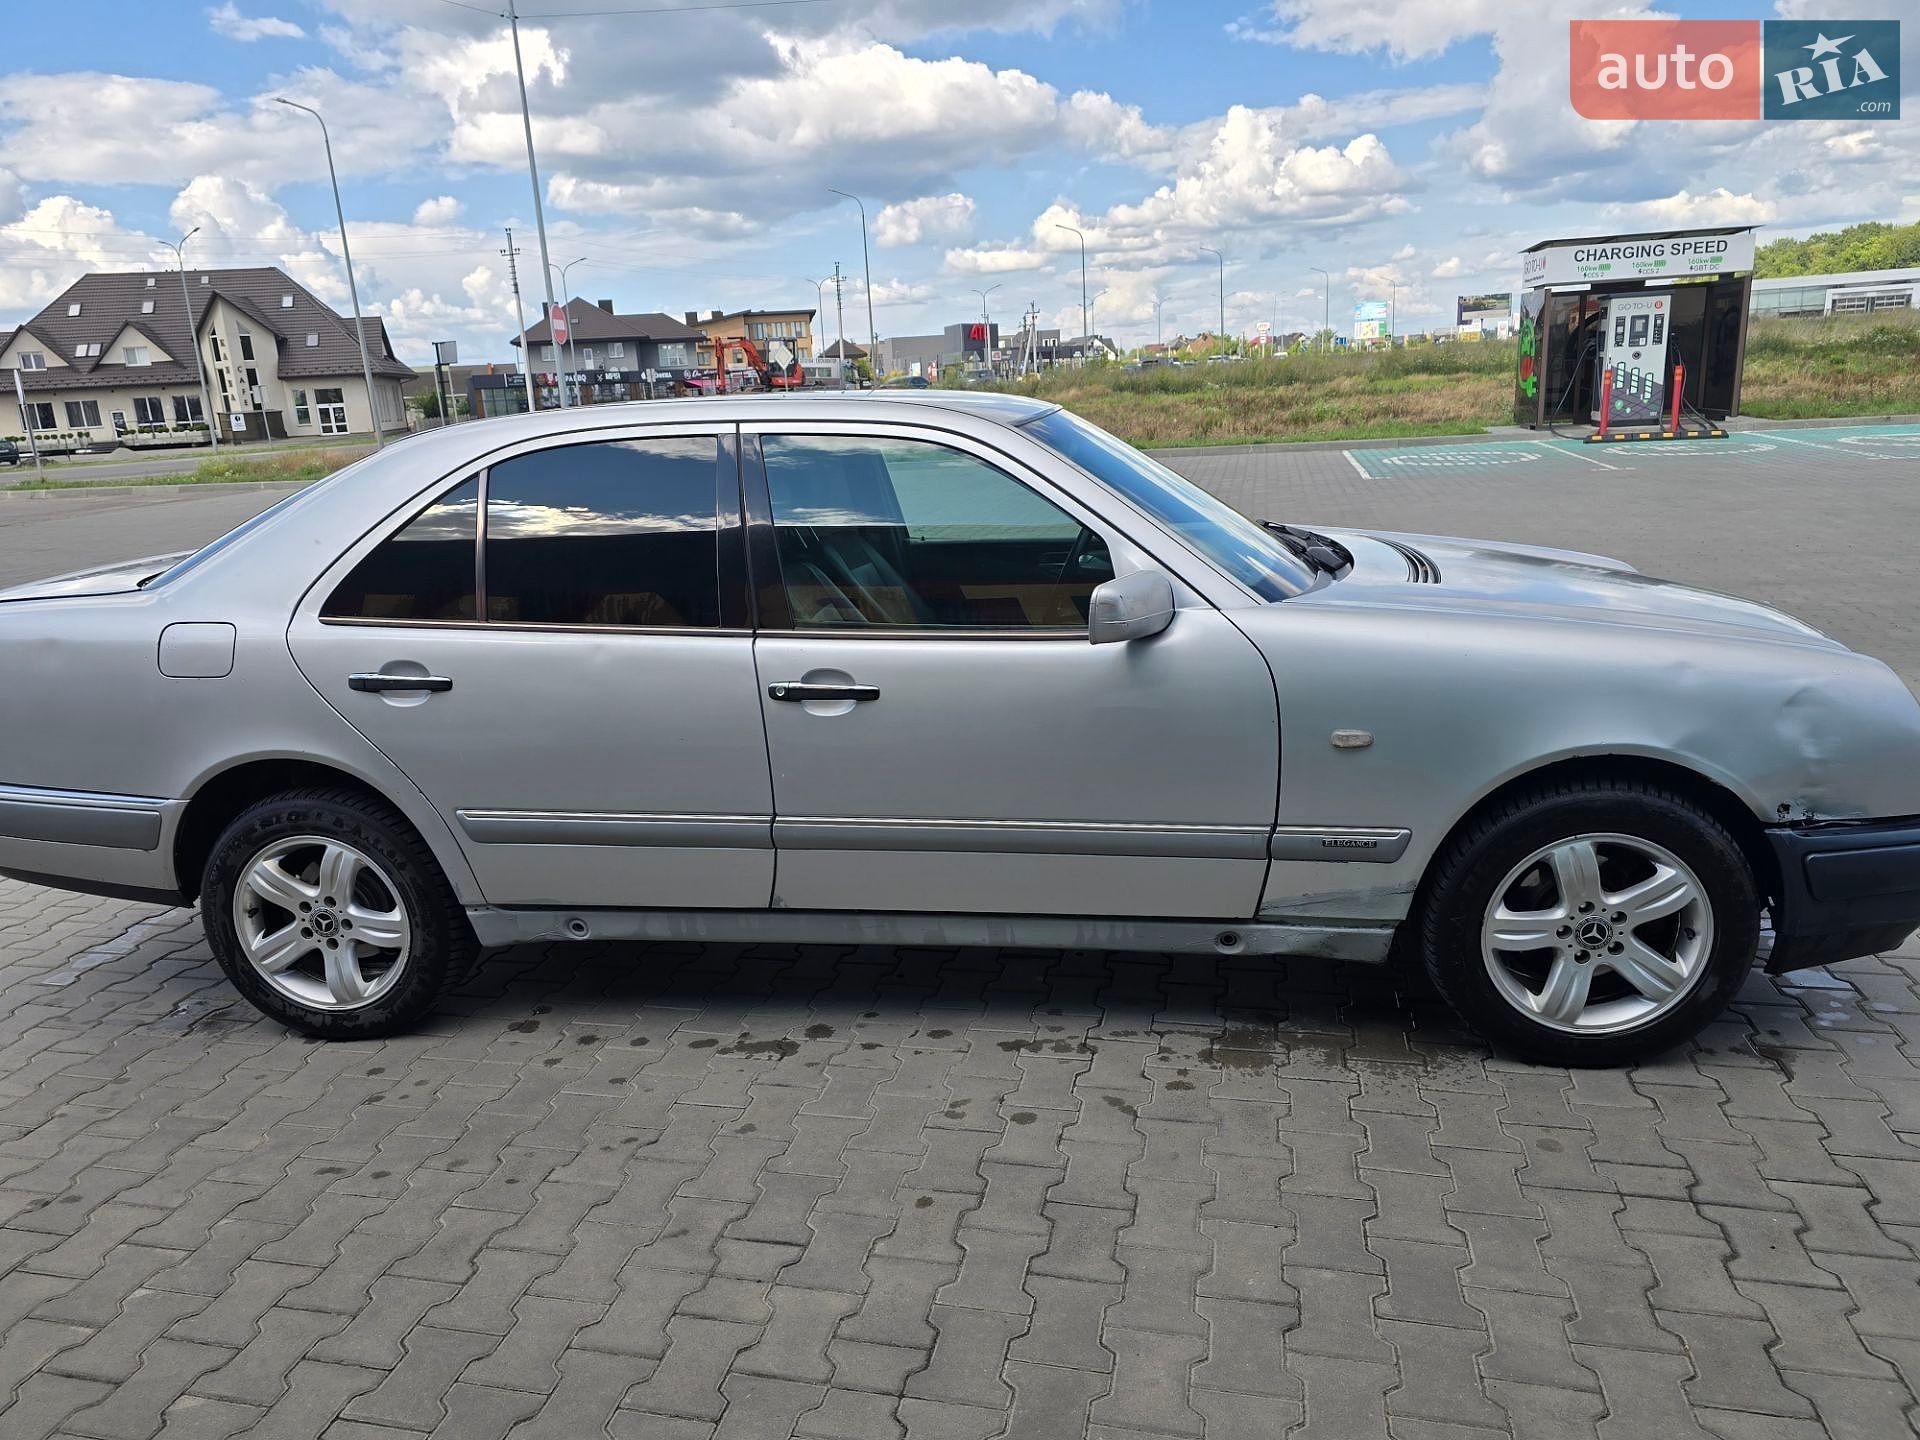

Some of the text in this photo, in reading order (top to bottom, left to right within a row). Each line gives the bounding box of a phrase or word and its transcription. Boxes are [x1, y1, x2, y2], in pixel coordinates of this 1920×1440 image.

[1574, 240, 1728, 262] CHARGING SPEED
[1325, 839, 1375, 848] ELEGANCE
